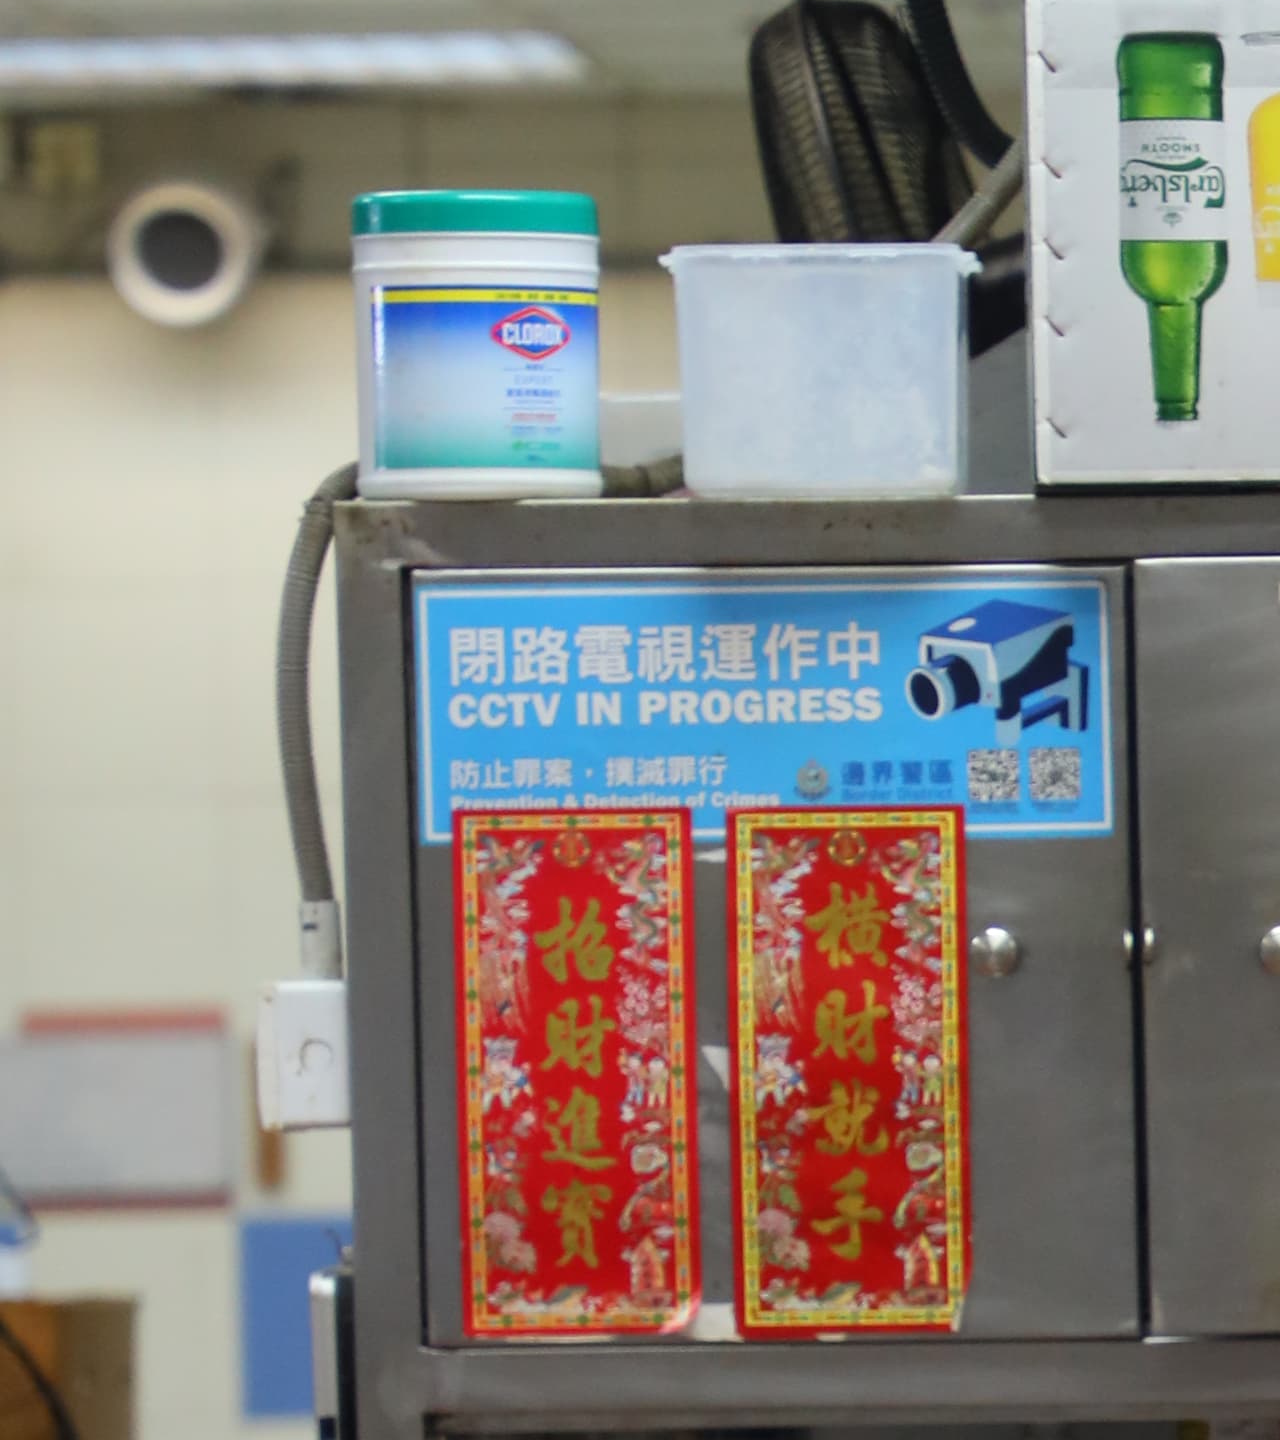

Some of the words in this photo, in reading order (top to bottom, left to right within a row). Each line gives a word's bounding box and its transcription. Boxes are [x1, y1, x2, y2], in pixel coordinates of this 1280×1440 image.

[1141, 142, 1200, 154] SMOOTH
[502, 322, 563, 346] CLOROX
[450, 621, 883, 687] 閉路電視運作中
[450, 692, 561, 729] CCTV
[576, 691, 622, 727] IN
[639, 687, 884, 725] PROGRESS
[686, 792, 705, 808] of
[711, 790, 780, 809] Crimes
[535, 897, 617, 1269] 招財進寶
